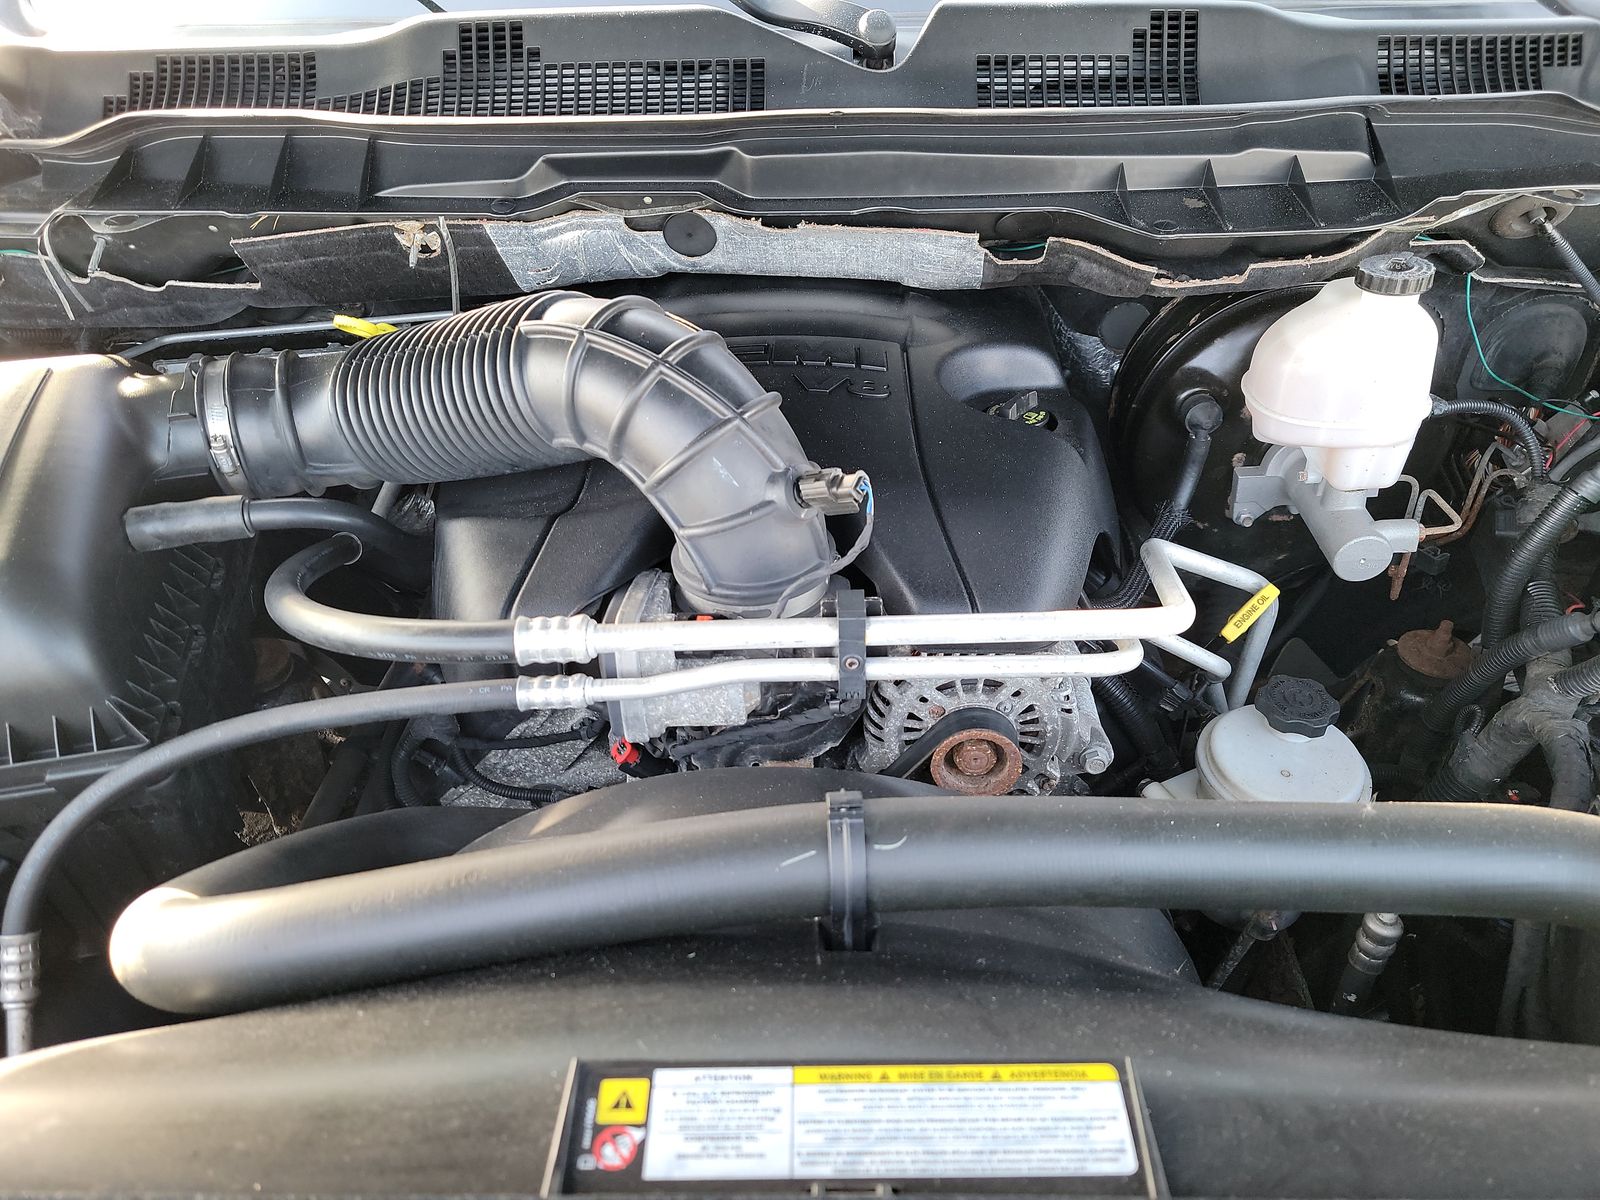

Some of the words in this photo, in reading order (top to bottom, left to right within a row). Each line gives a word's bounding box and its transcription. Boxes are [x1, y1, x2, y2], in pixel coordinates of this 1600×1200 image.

[792, 372, 891, 398] V8
[1234, 604, 1260, 629] ENGINE
[1257, 595, 1270, 606] OIL
